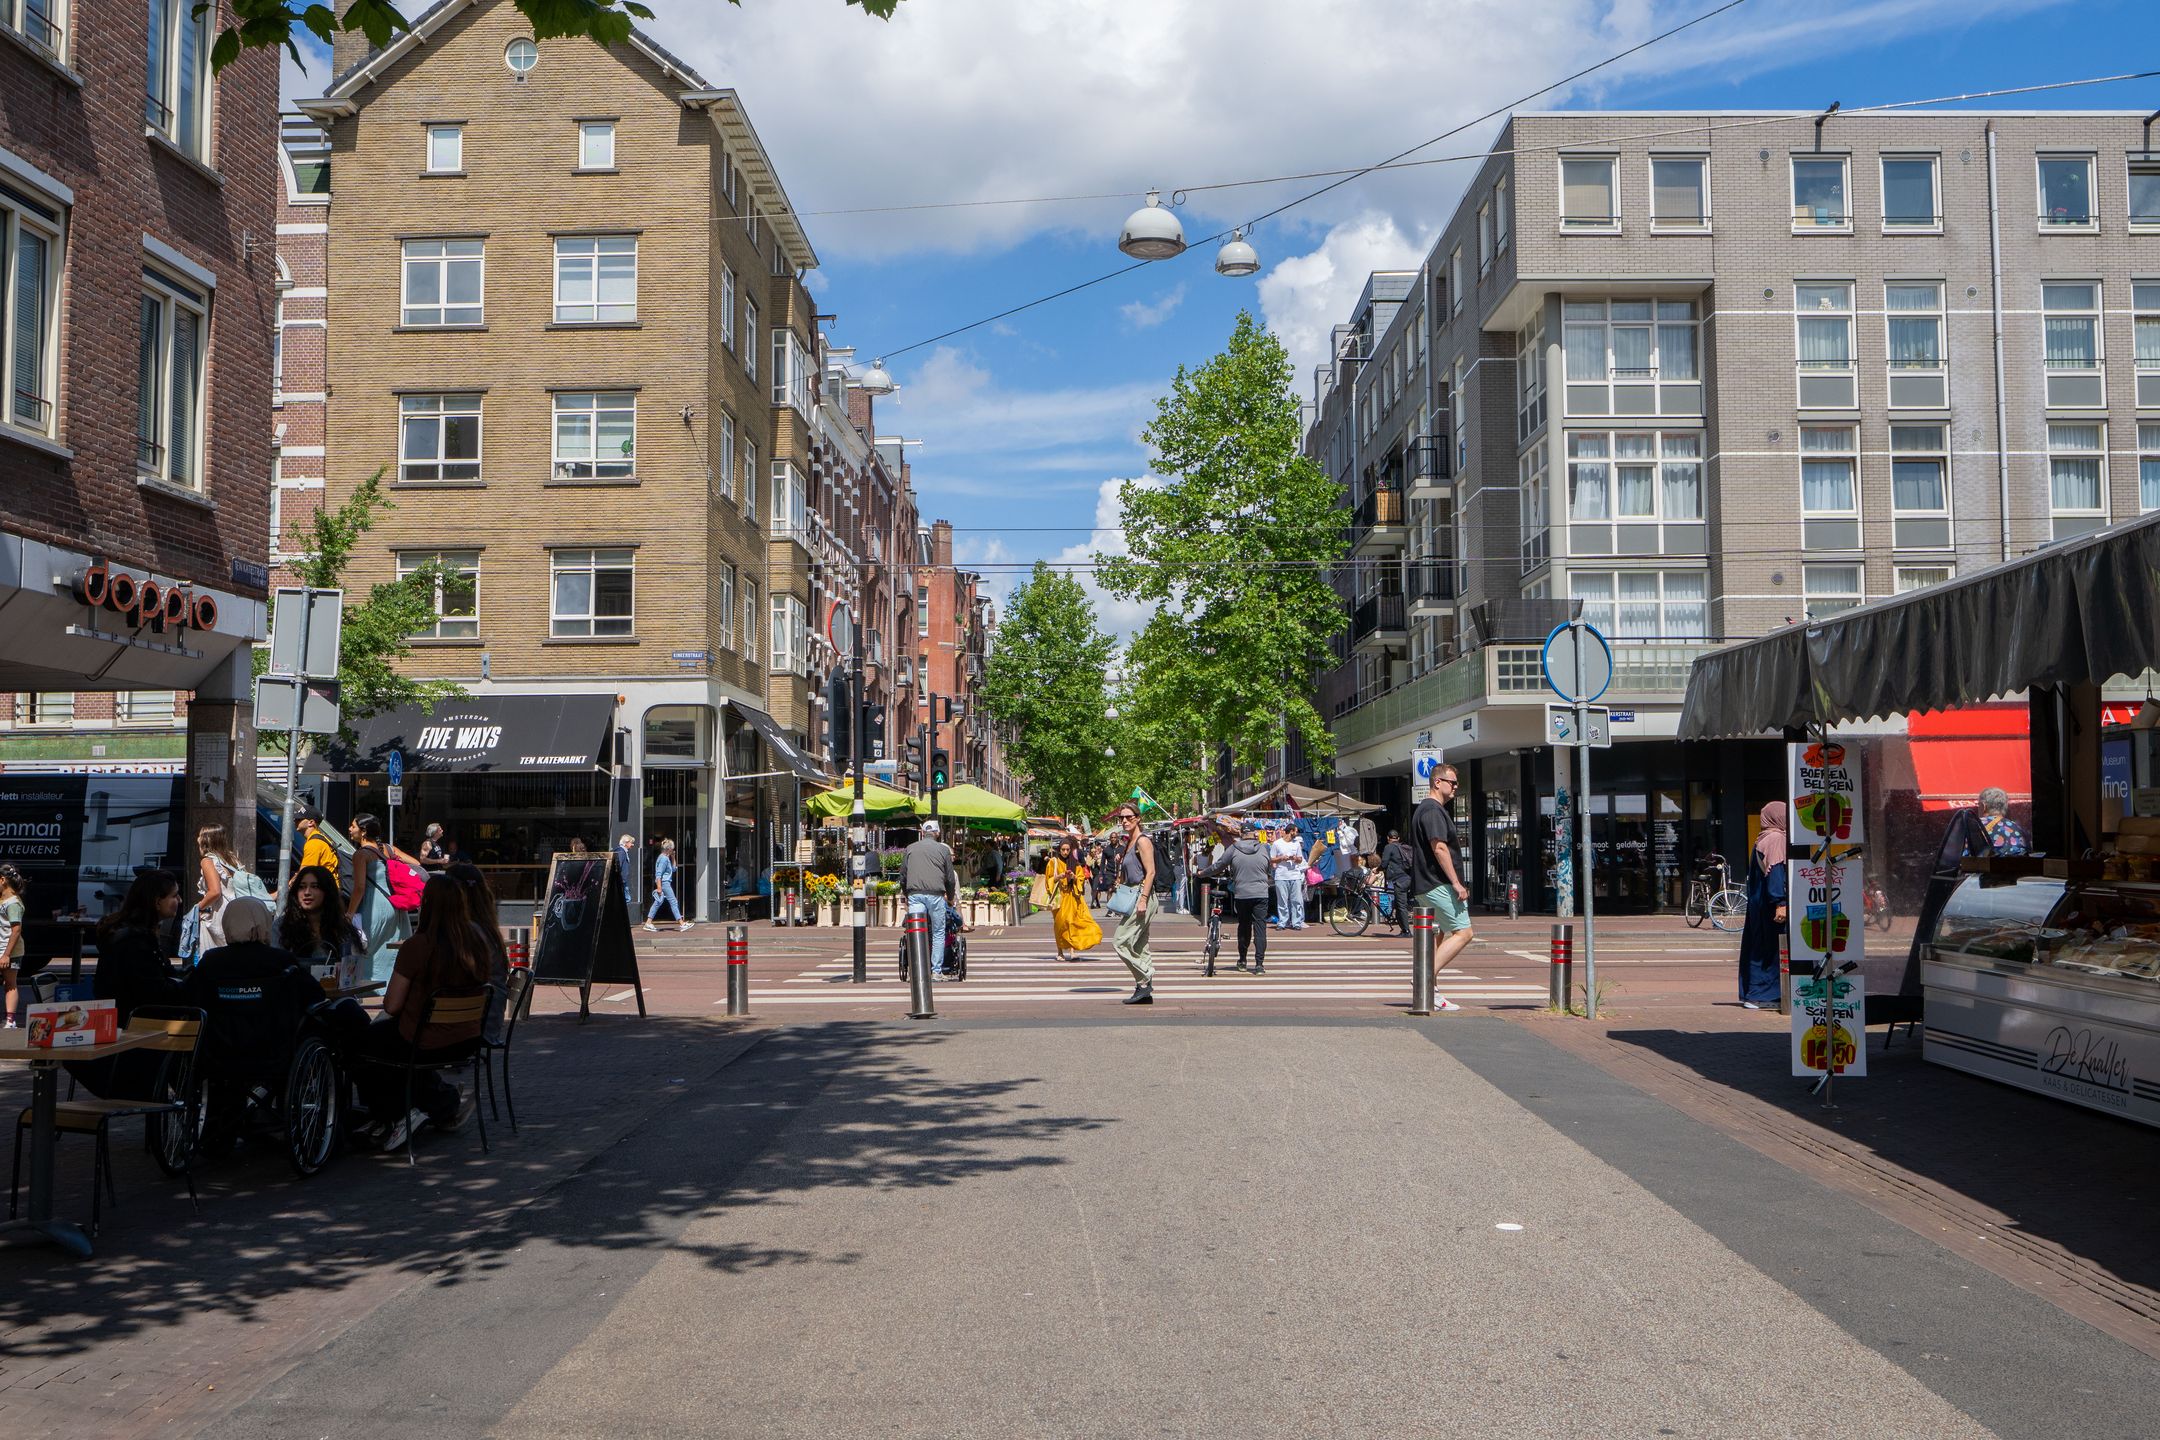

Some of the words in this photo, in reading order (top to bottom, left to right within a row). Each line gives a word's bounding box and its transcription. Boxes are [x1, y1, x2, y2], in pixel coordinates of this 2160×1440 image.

[80, 559, 218, 632] doppio
[443, 714, 489, 722] AMSTERDAM
[416, 727, 454, 749] FIVE
[455, 726, 503, 749] WAYS
[519, 756, 534, 765] TEN
[536, 755, 588, 764] KATEMARKT
[21, 792, 64, 800] installateur
[8, 844, 60, 854] KEUKENS
[1805, 1005, 1854, 1019] SCHPEN
[1812, 1017, 1842, 1030] KAS
[2043, 1076, 2061, 1091] KAAS
[2070, 1082, 2127, 1108] DELICATESSEN
